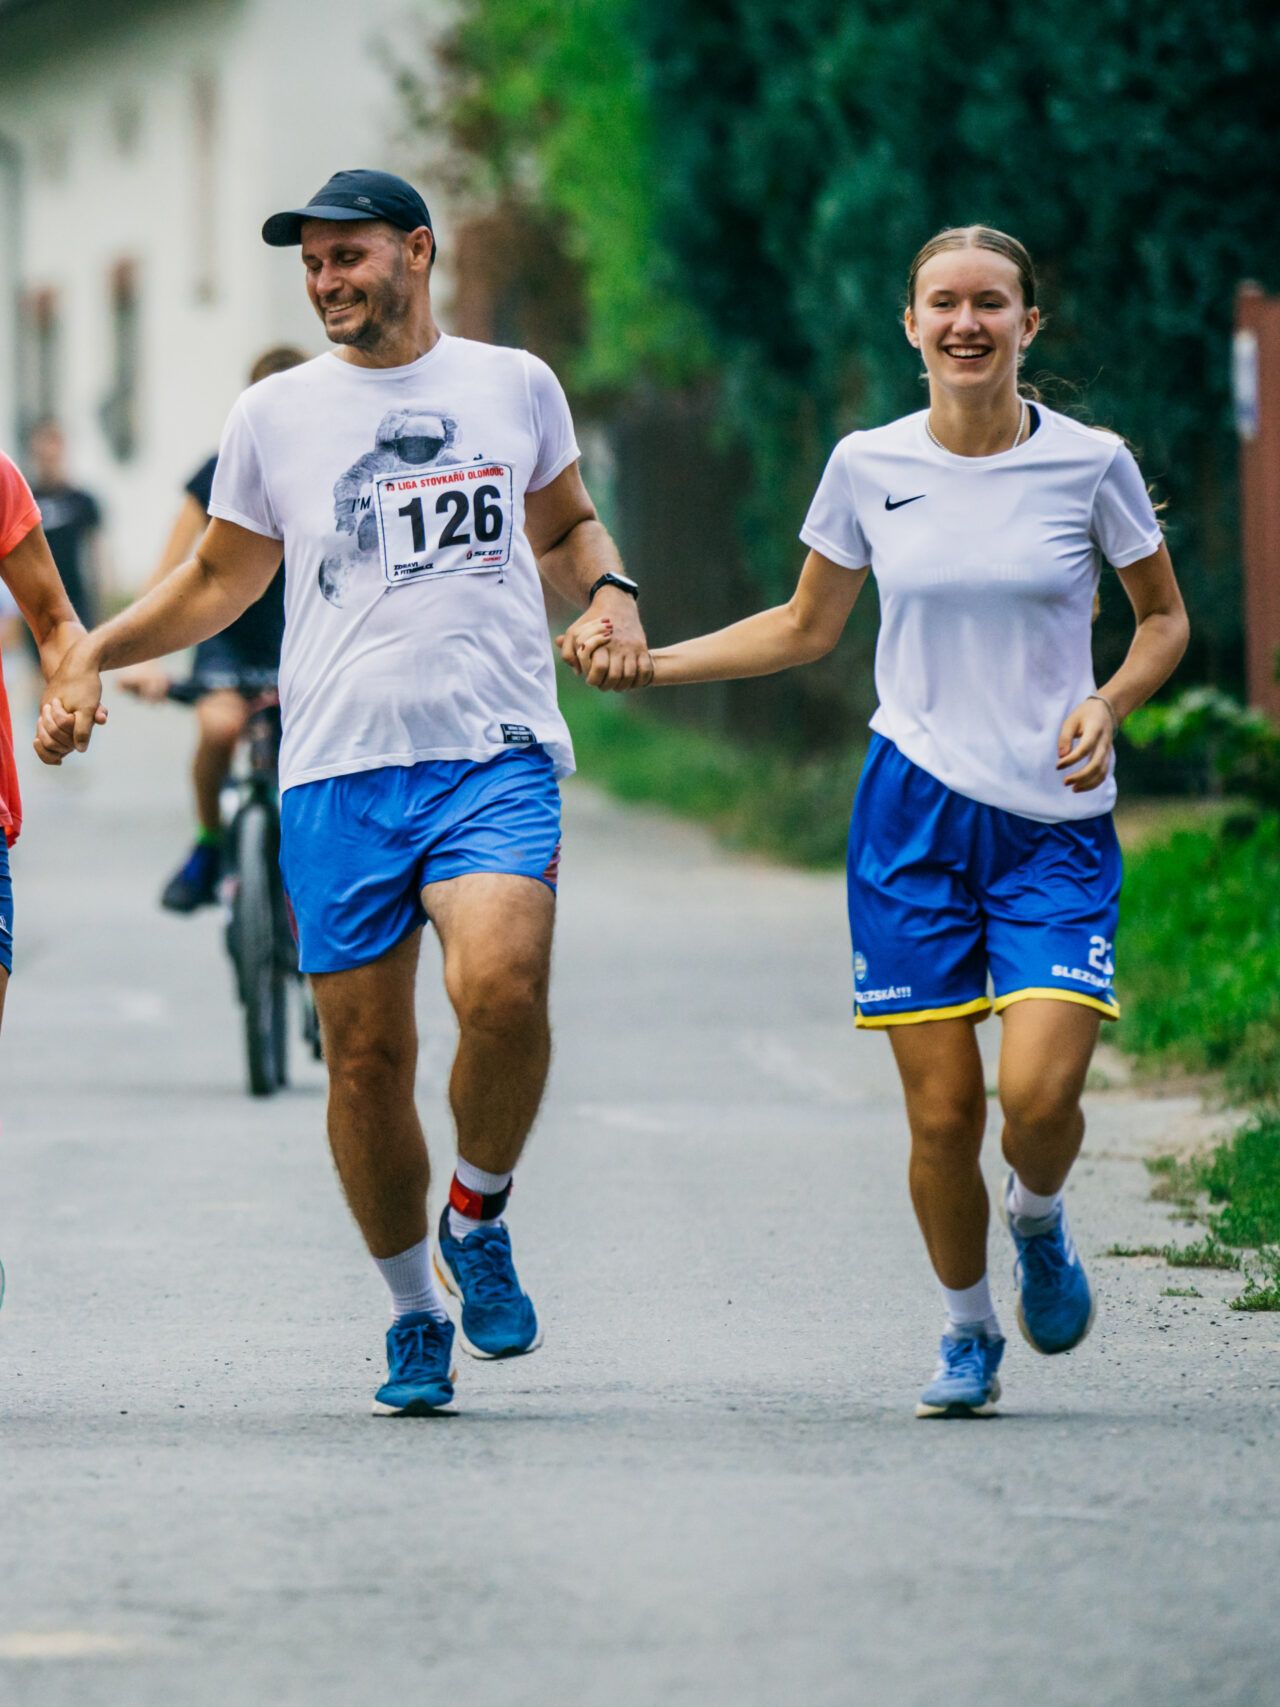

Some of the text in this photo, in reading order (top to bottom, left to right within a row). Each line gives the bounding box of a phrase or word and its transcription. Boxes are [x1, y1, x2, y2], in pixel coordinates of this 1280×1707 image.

[398, 479, 417, 491] LIGA
[420, 471, 465, 488] STOVKAŘŮ
[468, 466, 504, 481] OLOMOUC
[351, 495, 371, 513] I'M
[398, 485, 504, 553] 126
[474, 549, 504, 557] SCOTT
